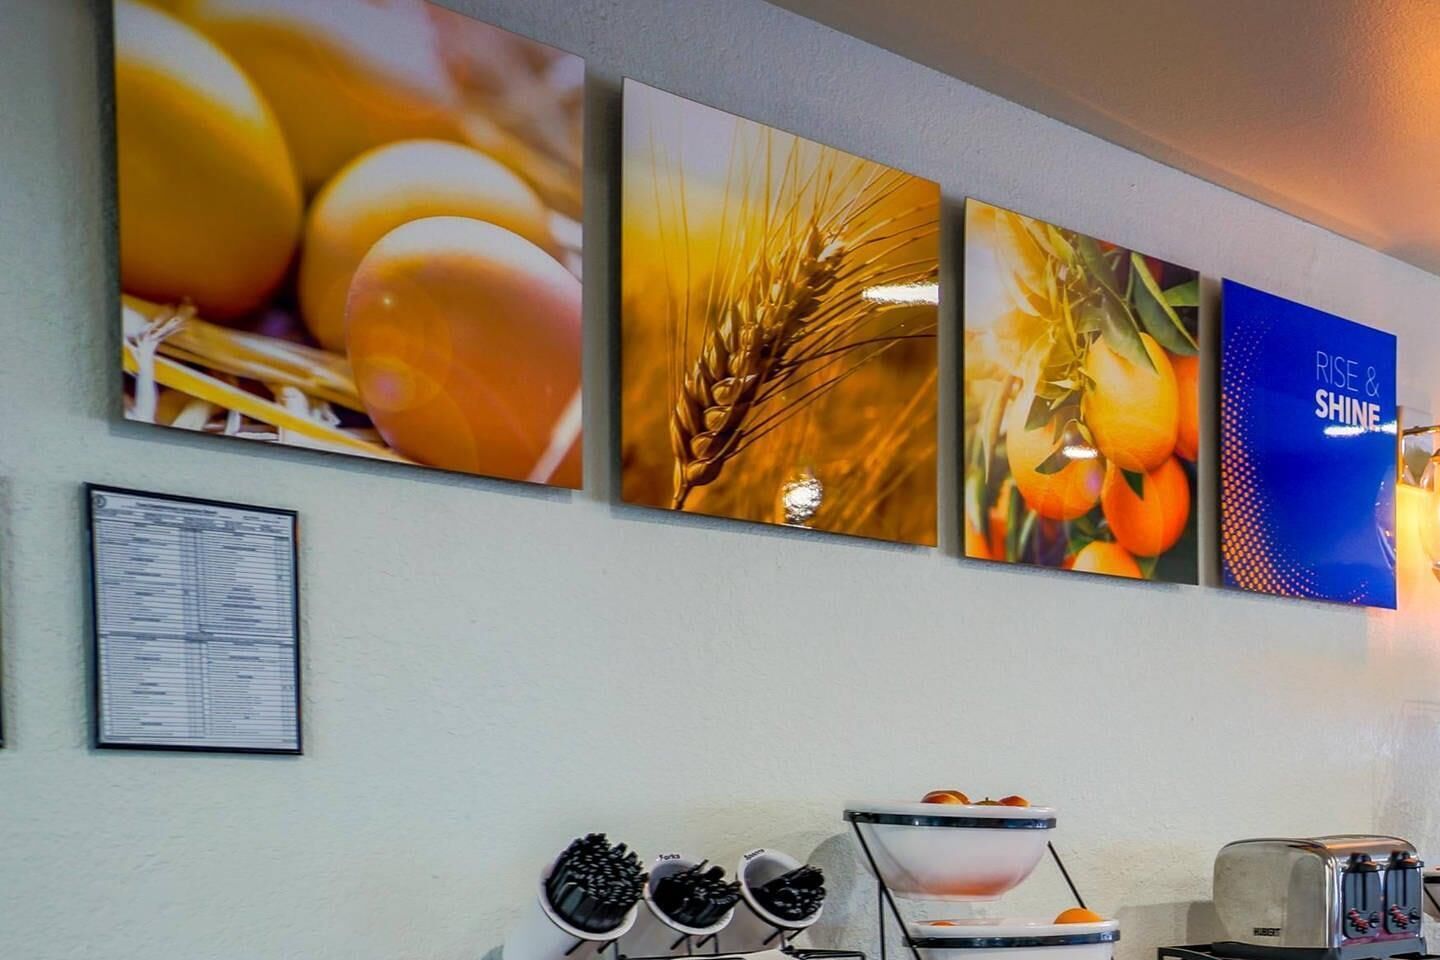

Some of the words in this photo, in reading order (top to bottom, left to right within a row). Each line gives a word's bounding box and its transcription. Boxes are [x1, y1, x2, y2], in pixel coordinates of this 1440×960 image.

[1316, 350, 1359, 392] RISE
[1365, 365, 1380, 398] &
[1315, 389, 1380, 432] SHINE
